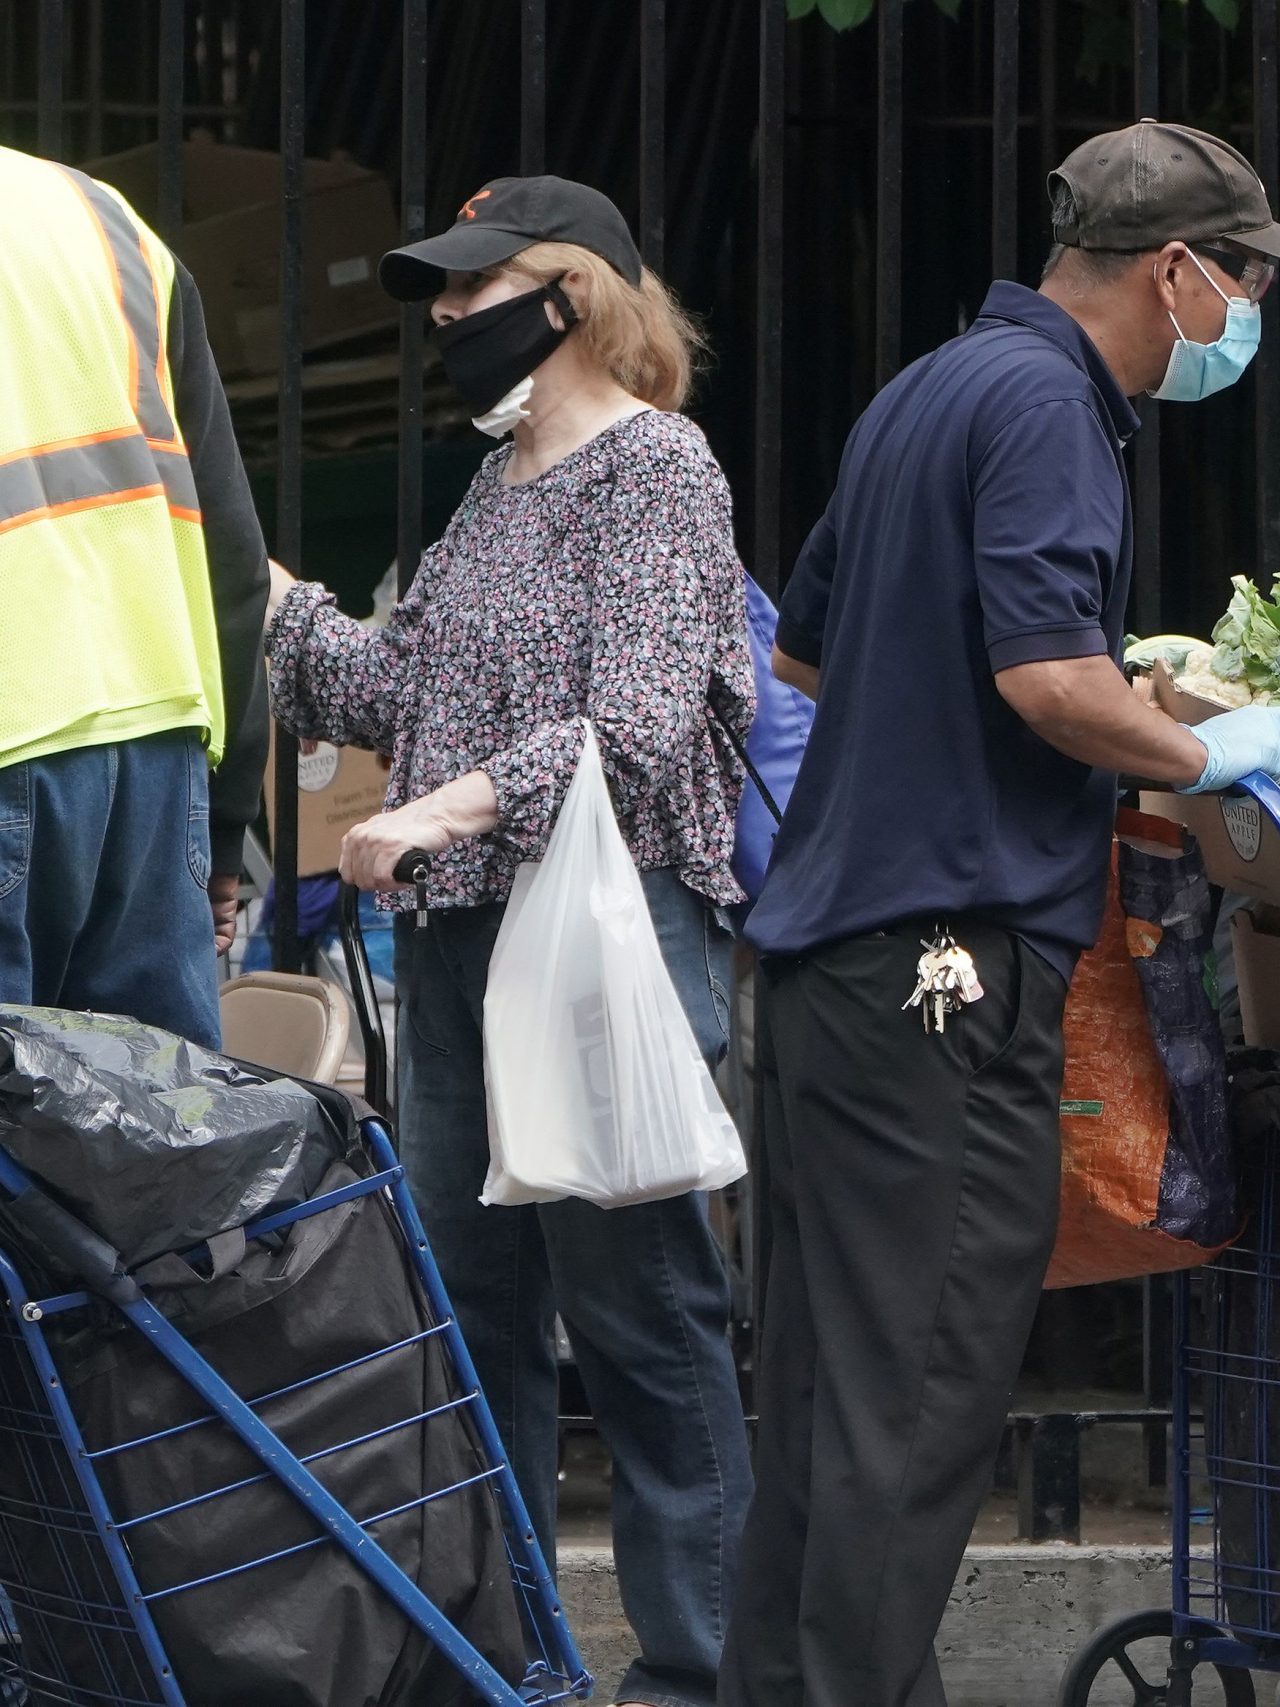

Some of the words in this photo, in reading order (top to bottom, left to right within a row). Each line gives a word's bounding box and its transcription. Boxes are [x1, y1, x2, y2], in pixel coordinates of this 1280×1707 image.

[298, 754, 335, 771] NITED
[1225, 806, 1258, 827] UNITED
[1232, 822, 1256, 840] APPLE
